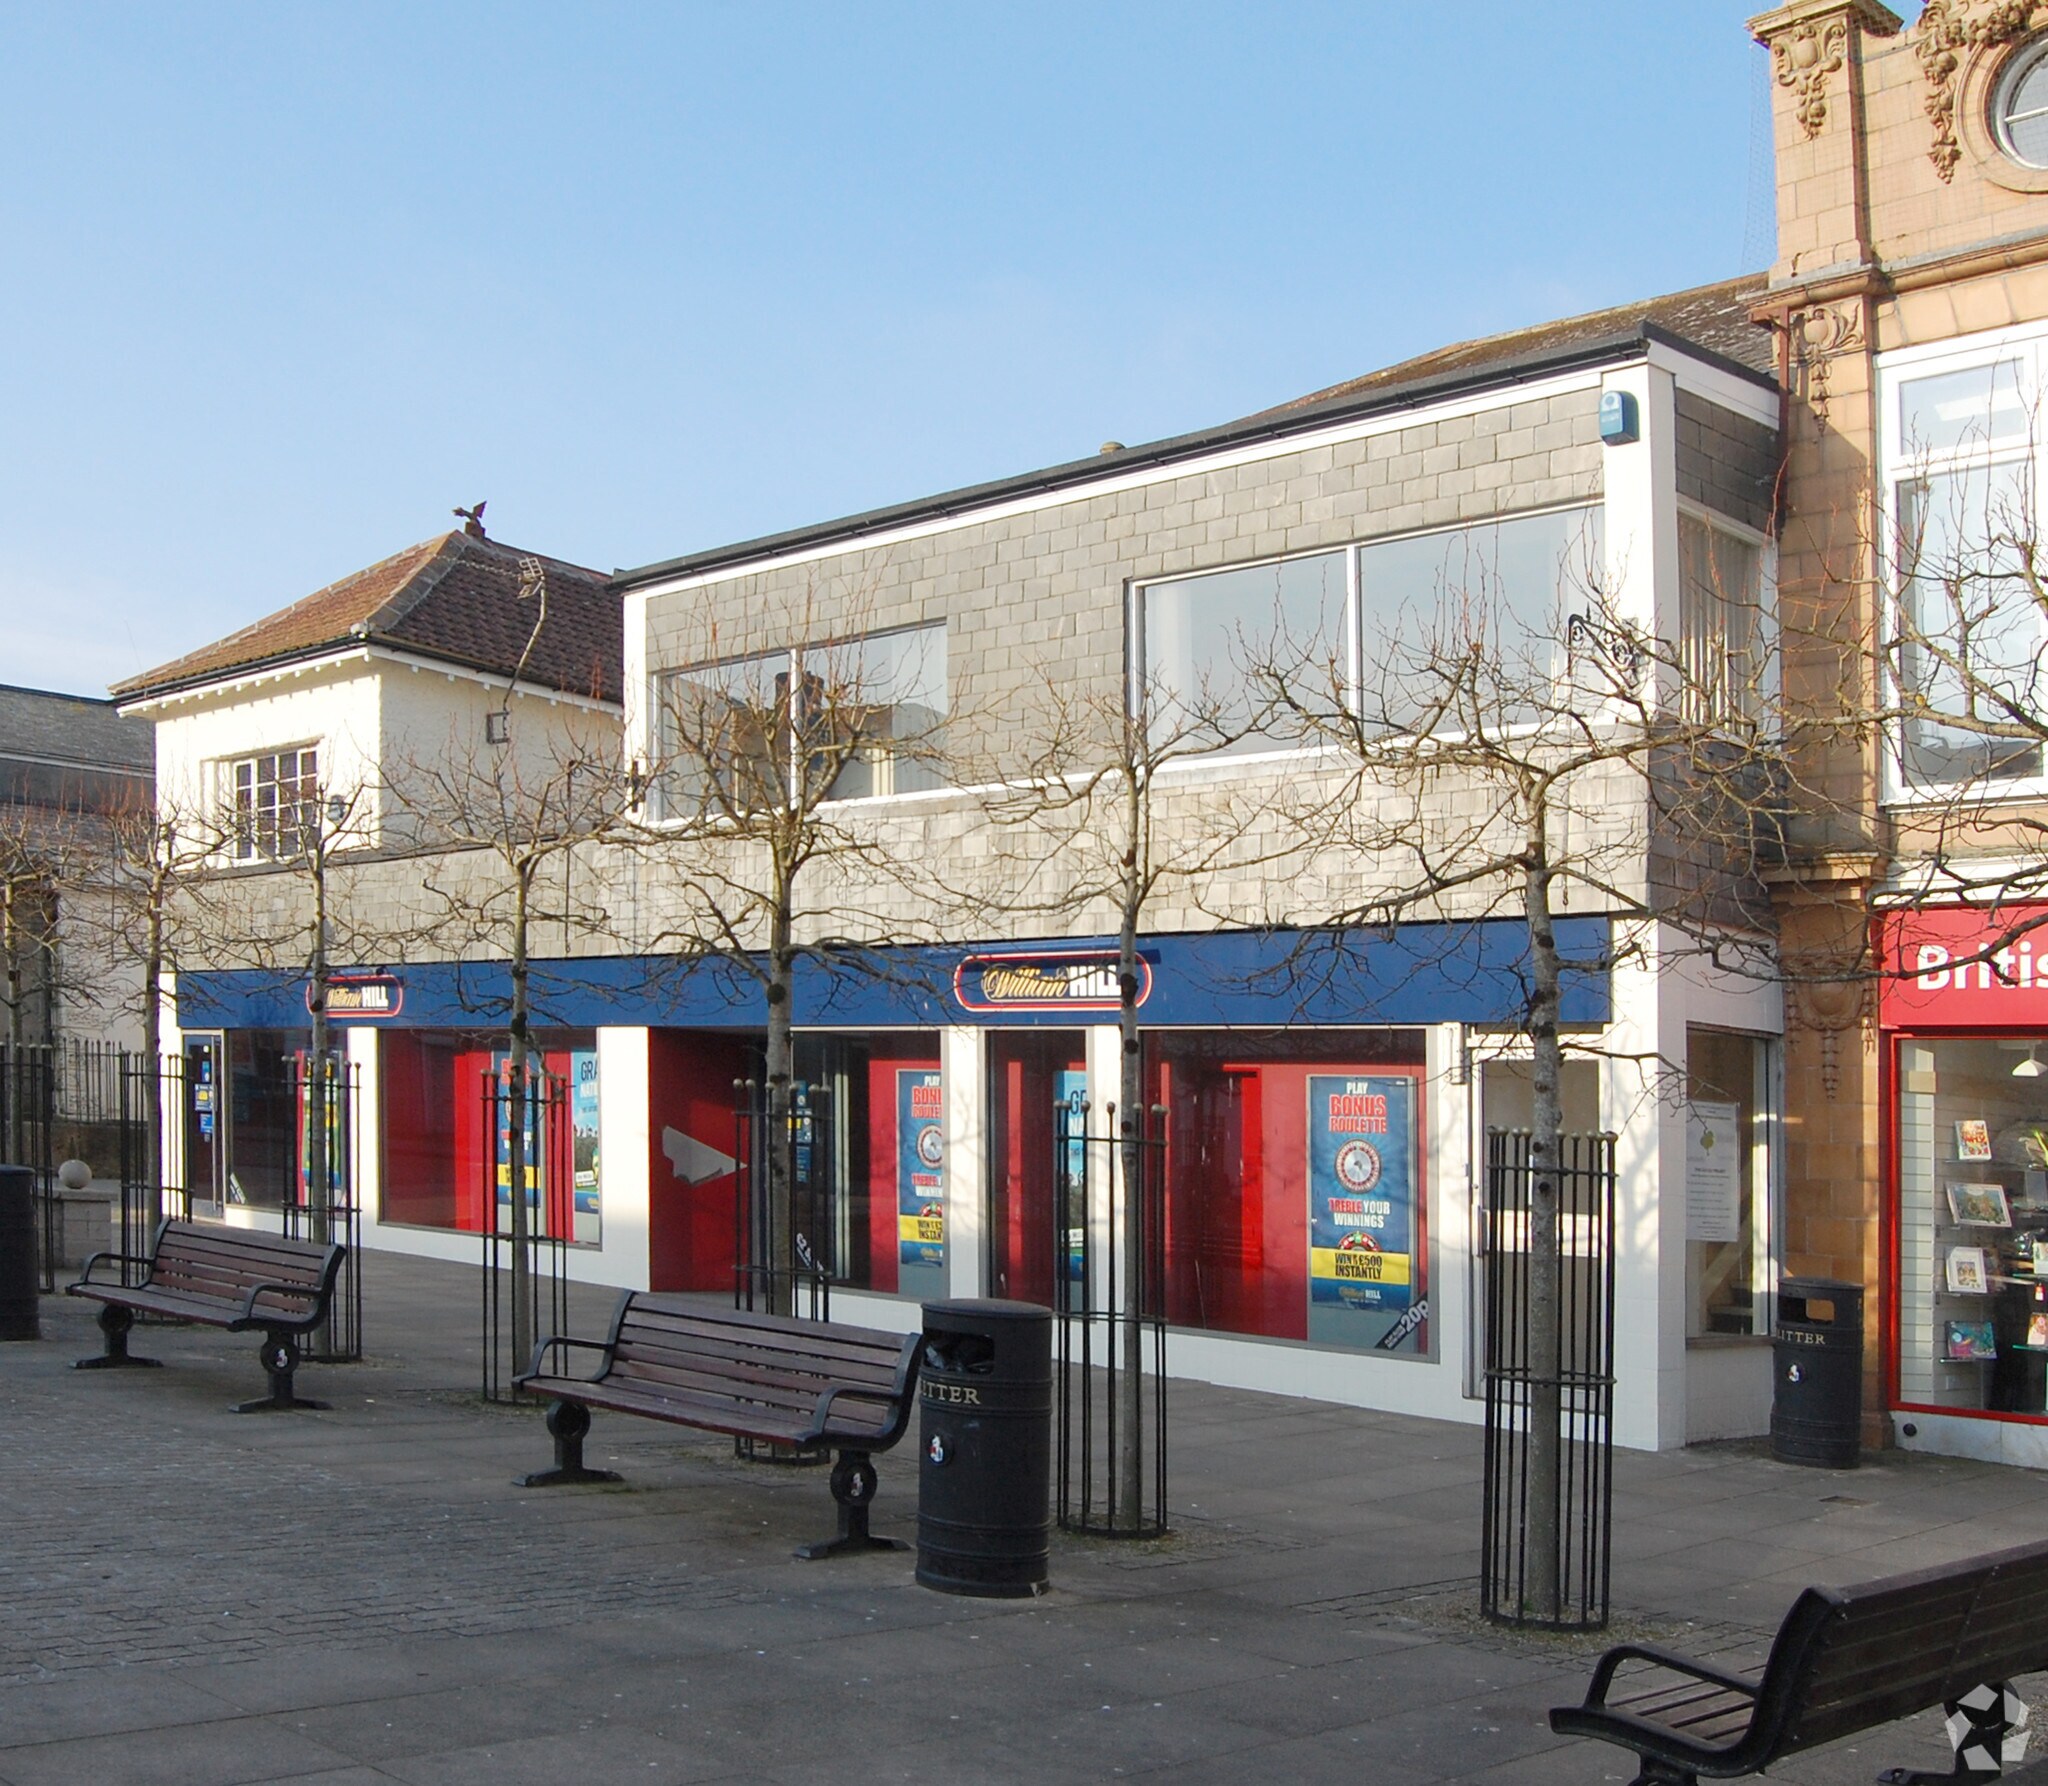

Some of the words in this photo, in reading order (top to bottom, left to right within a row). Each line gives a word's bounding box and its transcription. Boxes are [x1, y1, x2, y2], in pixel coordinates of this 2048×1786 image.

[981, 965, 1068, 999] William
[1069, 964, 1122, 997] HILL
[362, 985, 389, 1008] HILL
[1346, 1082, 1368, 1095] PLAY
[1329, 1094, 1387, 1117] BONUS
[1328, 1116, 1387, 1134] ROULETTE
[1328, 1198, 1362, 1213] TREBLE
[1363, 1200, 1391, 1215] YOUR
[1334, 1212, 1385, 1229] WINNINGS
[1335, 1252, 1351, 1265] WIN
[1359, 1254, 1383, 1268] £500
[1335, 1264, 1383, 1280] INSTANTLY
[1400, 1300, 1428, 1333] 20p
